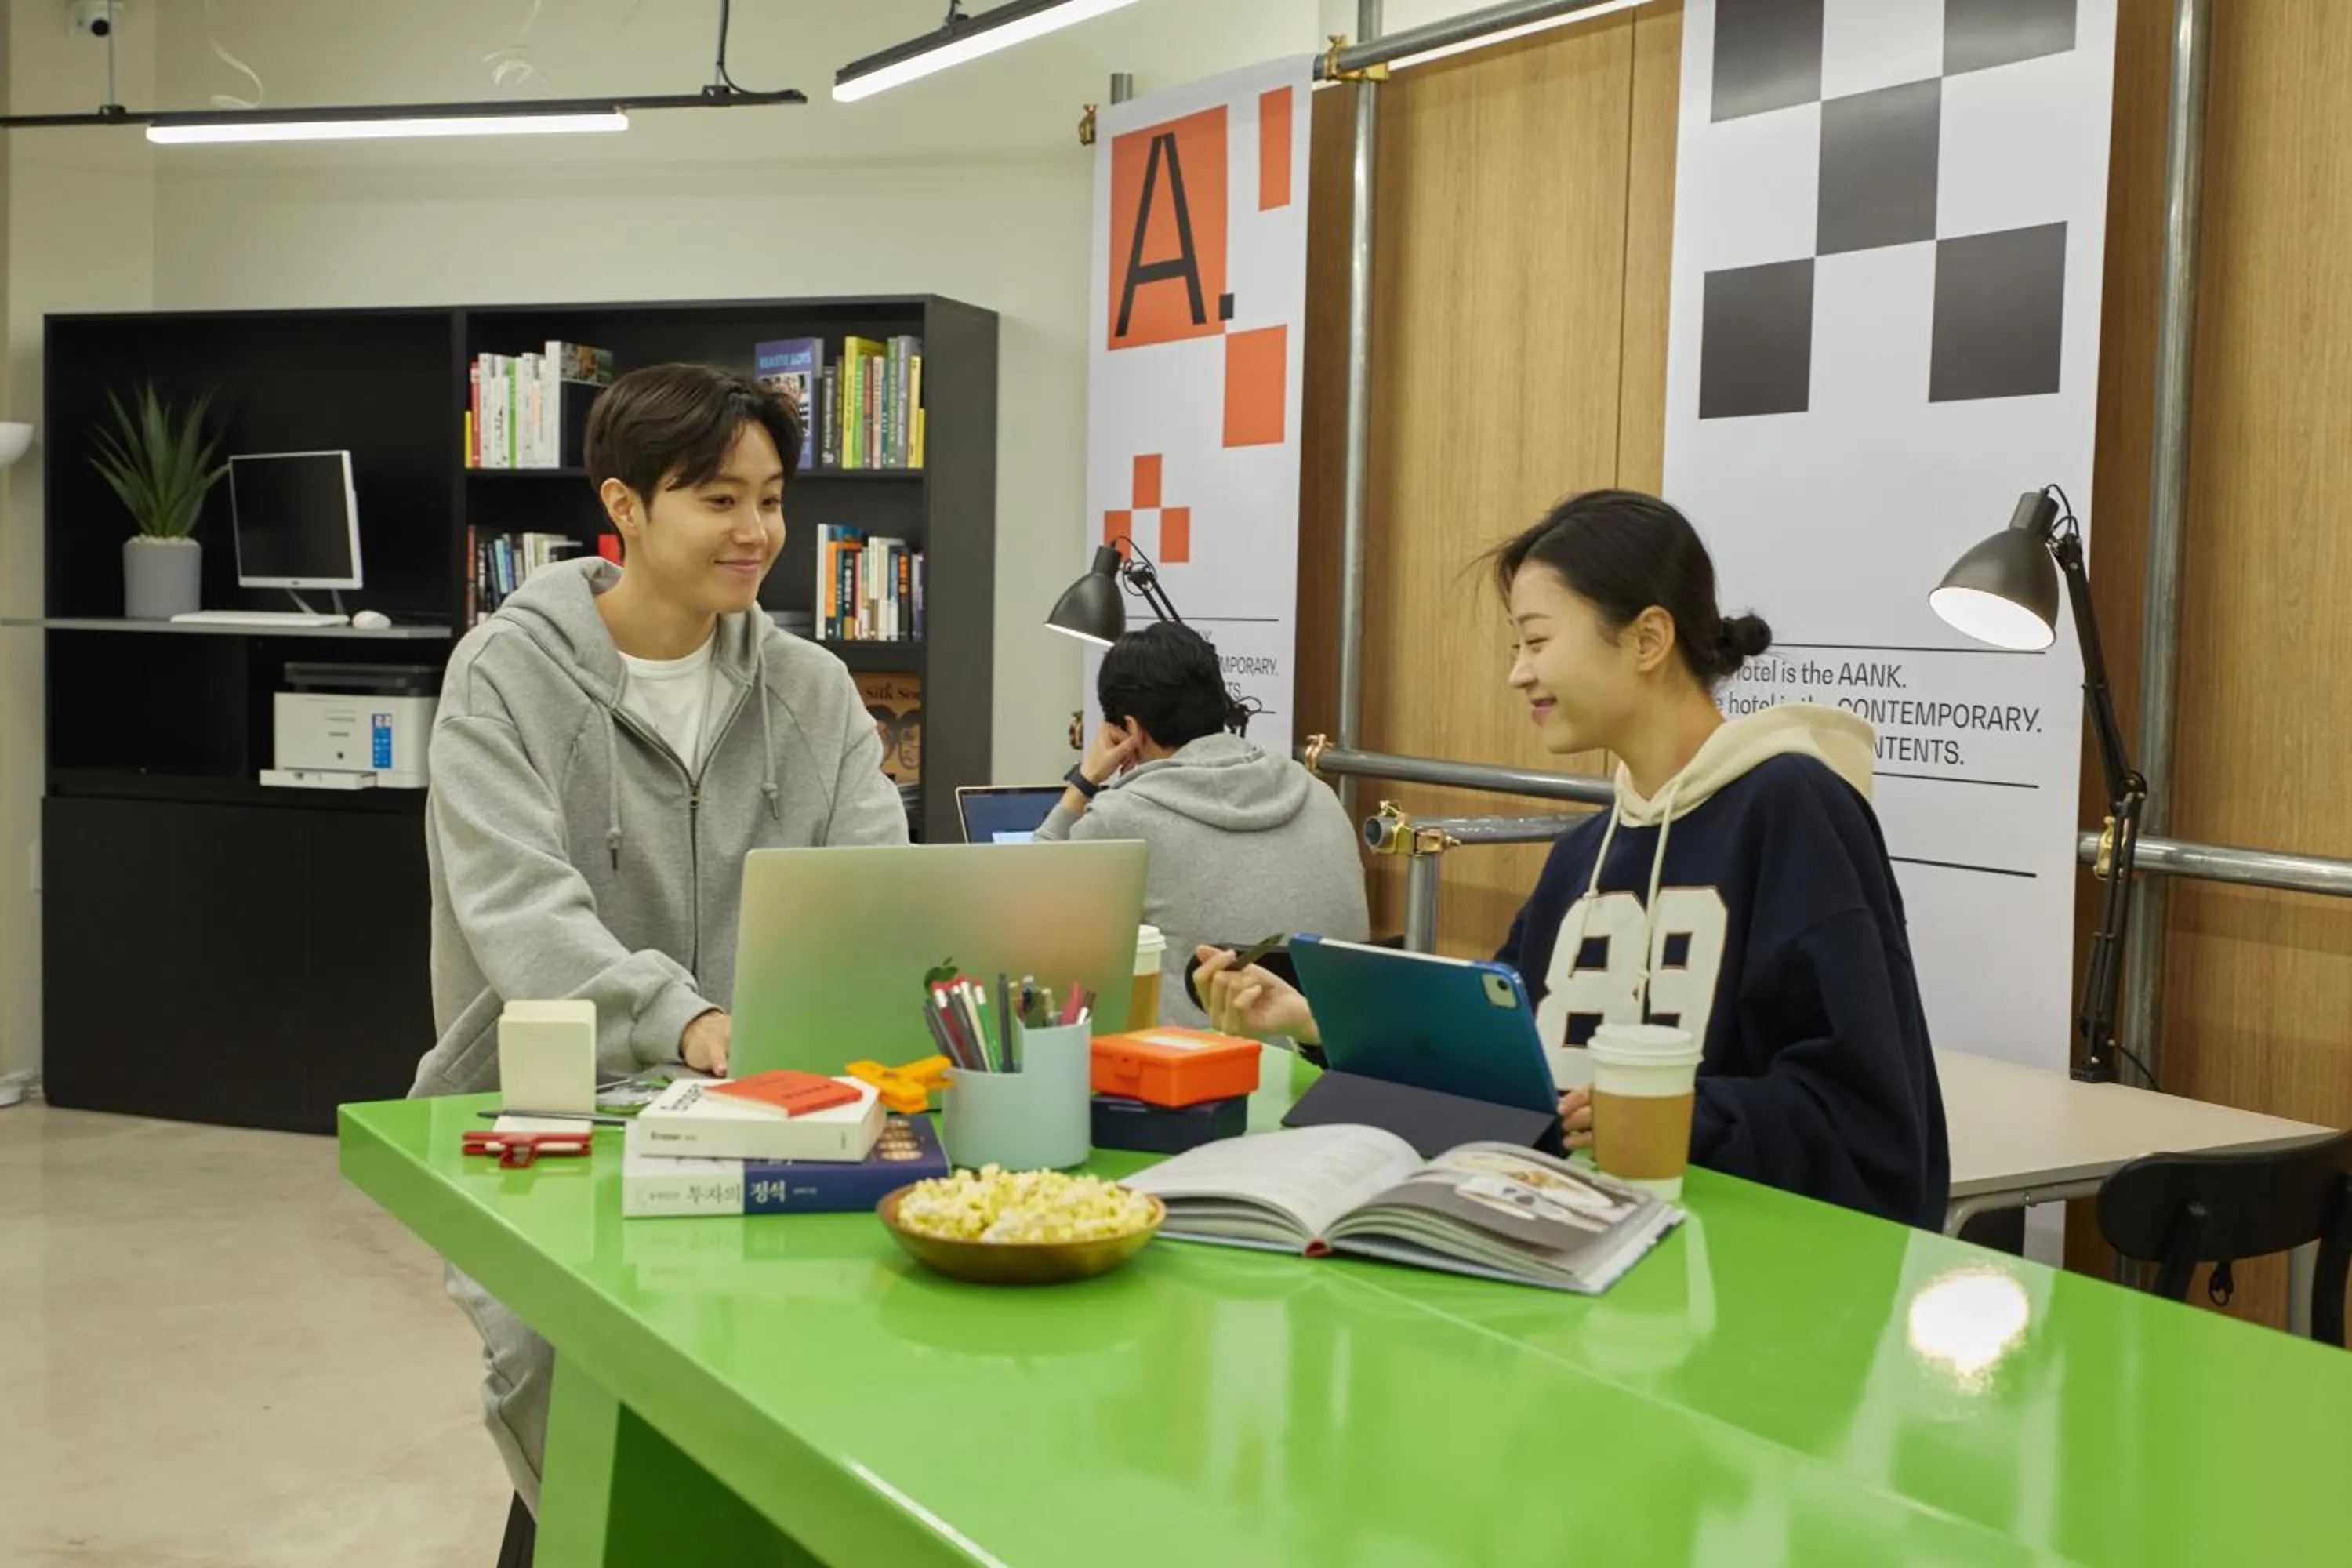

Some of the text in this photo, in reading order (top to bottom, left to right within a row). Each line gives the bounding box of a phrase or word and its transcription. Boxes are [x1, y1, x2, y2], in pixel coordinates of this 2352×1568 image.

[1115, 132, 1234, 337] A.
[1781, 661, 1796, 684] is
[1802, 660, 1834, 684] the
[1838, 662, 1907, 688] AANK.
[686, 1182, 741, 1206] 투자의
[750, 1179, 786, 1204] 정석
